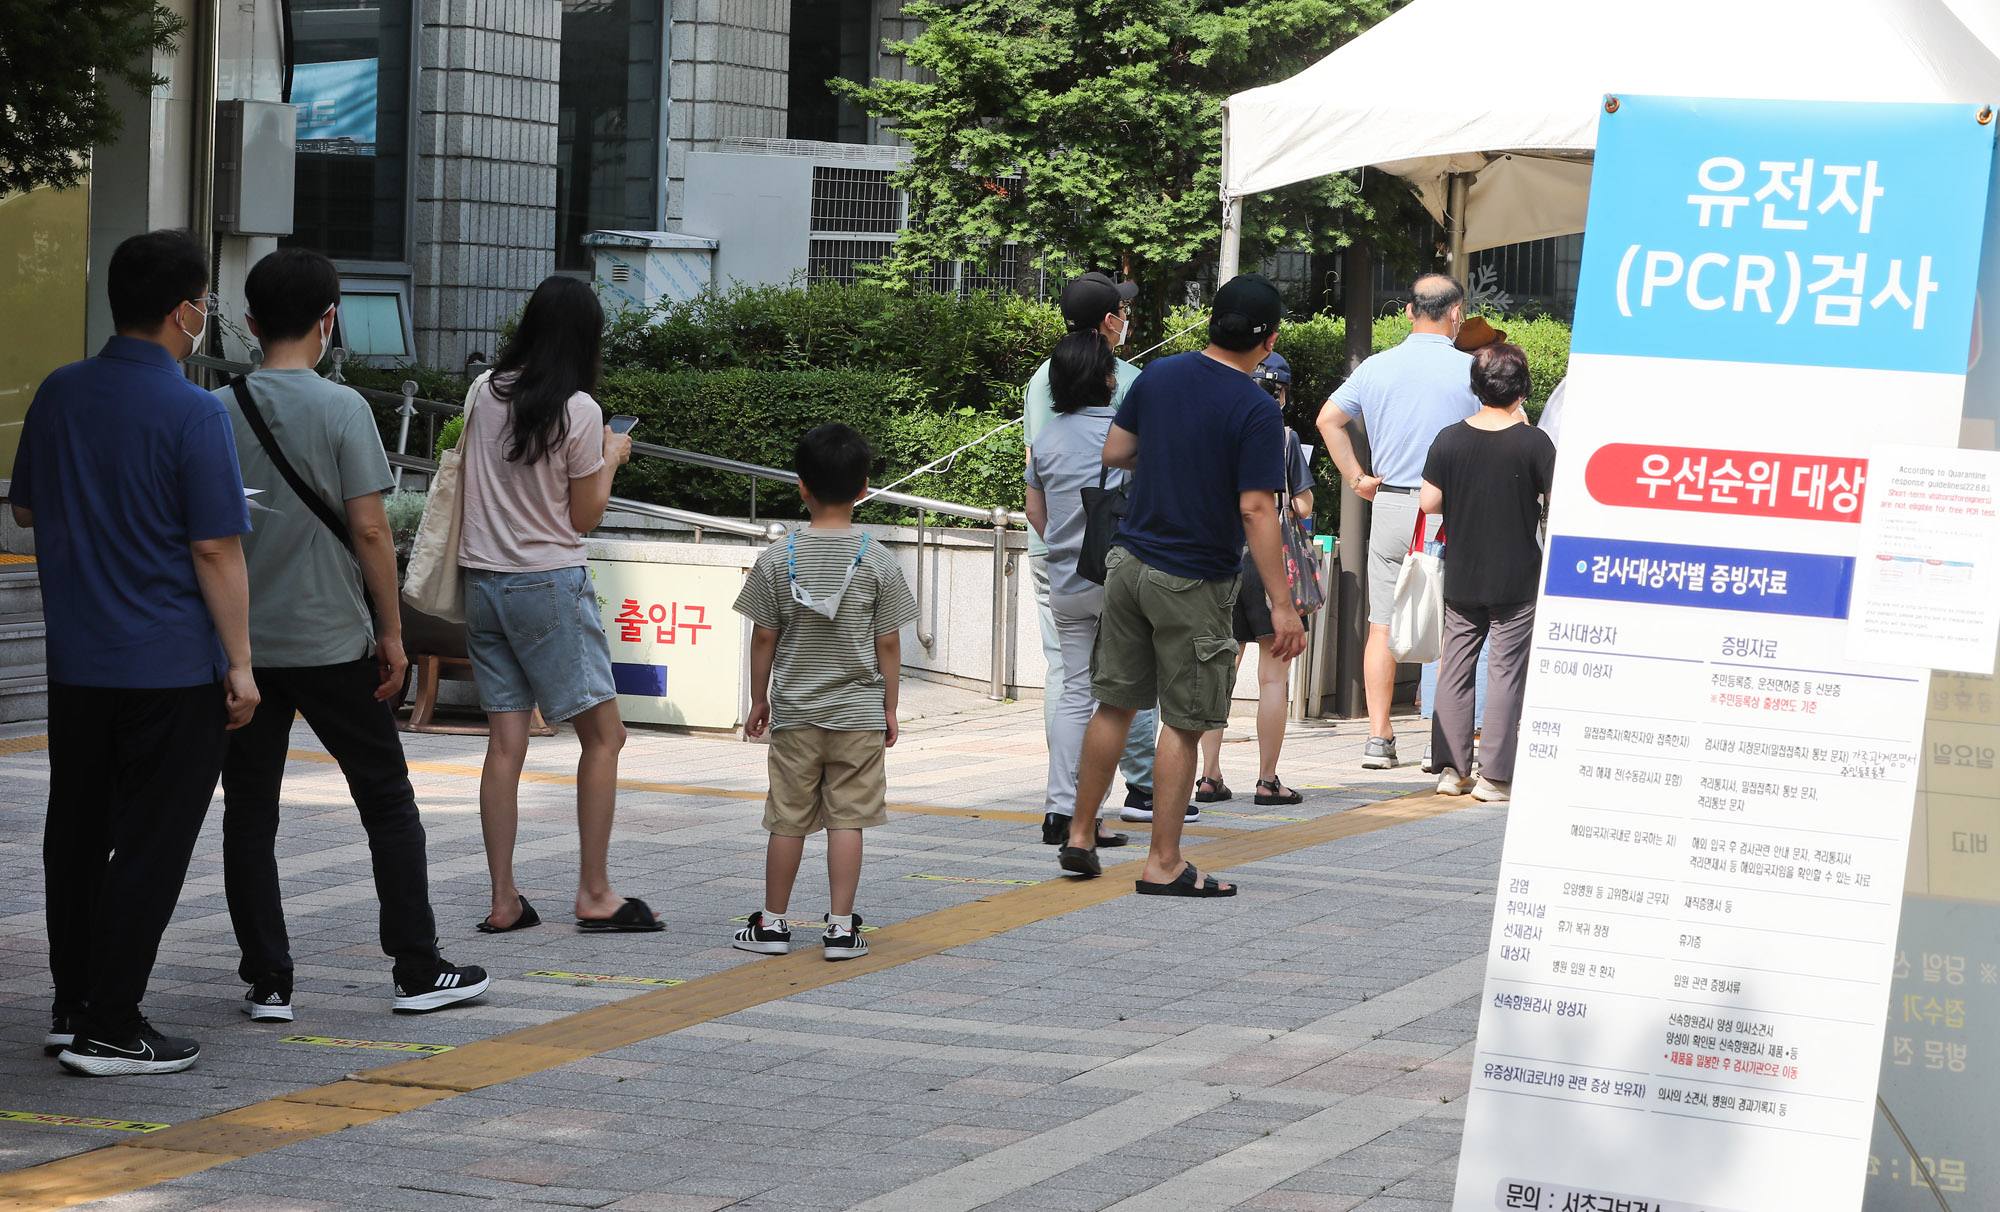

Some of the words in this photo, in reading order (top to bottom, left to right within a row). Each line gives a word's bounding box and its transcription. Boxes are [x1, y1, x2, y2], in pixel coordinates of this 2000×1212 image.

[1687, 156, 1885, 234] 유전자
[1616, 244, 1939, 330] (PCR)검사
[1891, 478, 1925, 488] response
[1899, 466, 1935, 477] According
[1938, 469, 1945, 477] to
[1948, 469, 1987, 480] Quarantine
[1636, 454, 1781, 507] 우선순위
[1791, 463, 1865, 514] 대상
[1888, 488, 1926, 499] Short-term
[1880, 501, 1892, 509] are
[1894, 502, 1906, 510] not
[1909, 503, 1933, 512] eligible
[1935, 505, 1946, 513] for
[1948, 506, 1963, 514] free
[1966, 508, 1979, 516] PCR
[1592, 555, 1706, 592] 검사대상자별
[1710, 563, 1788, 596] 증빙자료
[614, 598, 712, 645] 출입구
[1548, 622, 1618, 646] 검사대상자
[1721, 636, 1778, 659] 증빙자료
[1540, 658, 1550, 674] 만
[1553, 660, 1578, 676] 60세
[1582, 662, 1613, 679] 이상자
[1711, 674, 1753, 691] 주민등록증,
[1758, 677, 1800, 694] 운전면허증
[1803, 682, 1812, 695] 등
[1816, 682, 1841, 698] 신분증
[1763, 697, 1797, 713] 출생연도
[1800, 700, 1817, 714] 기준
[1531, 721, 1561, 737] 역학적
[1528, 742, 1558, 760] 연관자
[1704, 738, 1736, 753] 검사대상
[1812, 747, 1829, 762] 통보
[1578, 765, 1593, 778] 격리
[1782, 784, 1798, 798] 통보
[1697, 795, 1727, 811] 격리통보
[1729, 798, 1745, 812] 문자
[1692, 836, 1707, 850] 해외
[1710, 838, 1726, 852] 입국
[1728, 840, 1737, 853] 후
[1740, 842, 1770, 858] 검사관련
[1729, 859, 1737, 873] 등
[1824, 870, 1833, 883] 수
[1836, 871, 1852, 885] 있는
[1854, 873, 1871, 888] 자료
[1509, 878, 1530, 895] 감염
[1563, 882, 1593, 898] 요양병원
[1596, 886, 1604, 899] 등
[1647, 891, 1670, 906] 근무자
[1506, 900, 1546, 919] 취약시설
[1684, 895, 1722, 913] 재직증명서
[1724, 900, 1733, 914] 등
[1503, 922, 1543, 941] 선제검사
[1558, 920, 1573, 934] 휴가
[1575, 922, 1591, 935] 복귀
[1679, 933, 1702, 949] 휴가증
[1500, 944, 1531, 962] 대상자
[1552, 959, 1567, 974] 병원
[1570, 962, 1586, 976] 입원
[1588, 964, 1597, 978] 전
[1599, 965, 1616, 980] 환자
[1674, 974, 1689, 989] 입원
[1691, 977, 1708, 991] 관련
[1710, 978, 1741, 995] 증빙서류
[1493, 992, 1552, 1015] 신속항원검사
[1556, 1000, 1588, 1019] 양성자
[1668, 1012, 1714, 1030] 신속항원검사
[1717, 1018, 1733, 1033] 양성
[1735, 1020, 1775, 1038] 의사소견서
[1666, 1031, 1690, 1048] 양성이
[1693, 1035, 1716, 1051] 확인된
[1719, 1037, 1765, 1056] 신속항원검사
[1768, 1044, 1784, 1059] 제품
[1670, 1050, 1694, 1067] 제품을
[1696, 1054, 1720, 1070] 밀봉한
[1722, 1057, 1731, 1071] 후
[1733, 1059, 1780, 1078] 검사기관으로
[1782, 1065, 1798, 1080] 이동
[1484, 1063, 1565, 1088] 유증상자(코로나19
[1568, 1074, 1588, 1091] 관련
[1590, 1077, 1611, 1094] 증상
[1614, 1081, 1647, 1099] 보유자)
[1658, 1087, 1682, 1103] 의사의
[1712, 1094, 1736, 1110] 병원의
[1738, 1098, 1776, 1115] 경과기록지
[1779, 1103, 1787, 1117] 등
[1506, 1183, 1542, 1211] 문의
